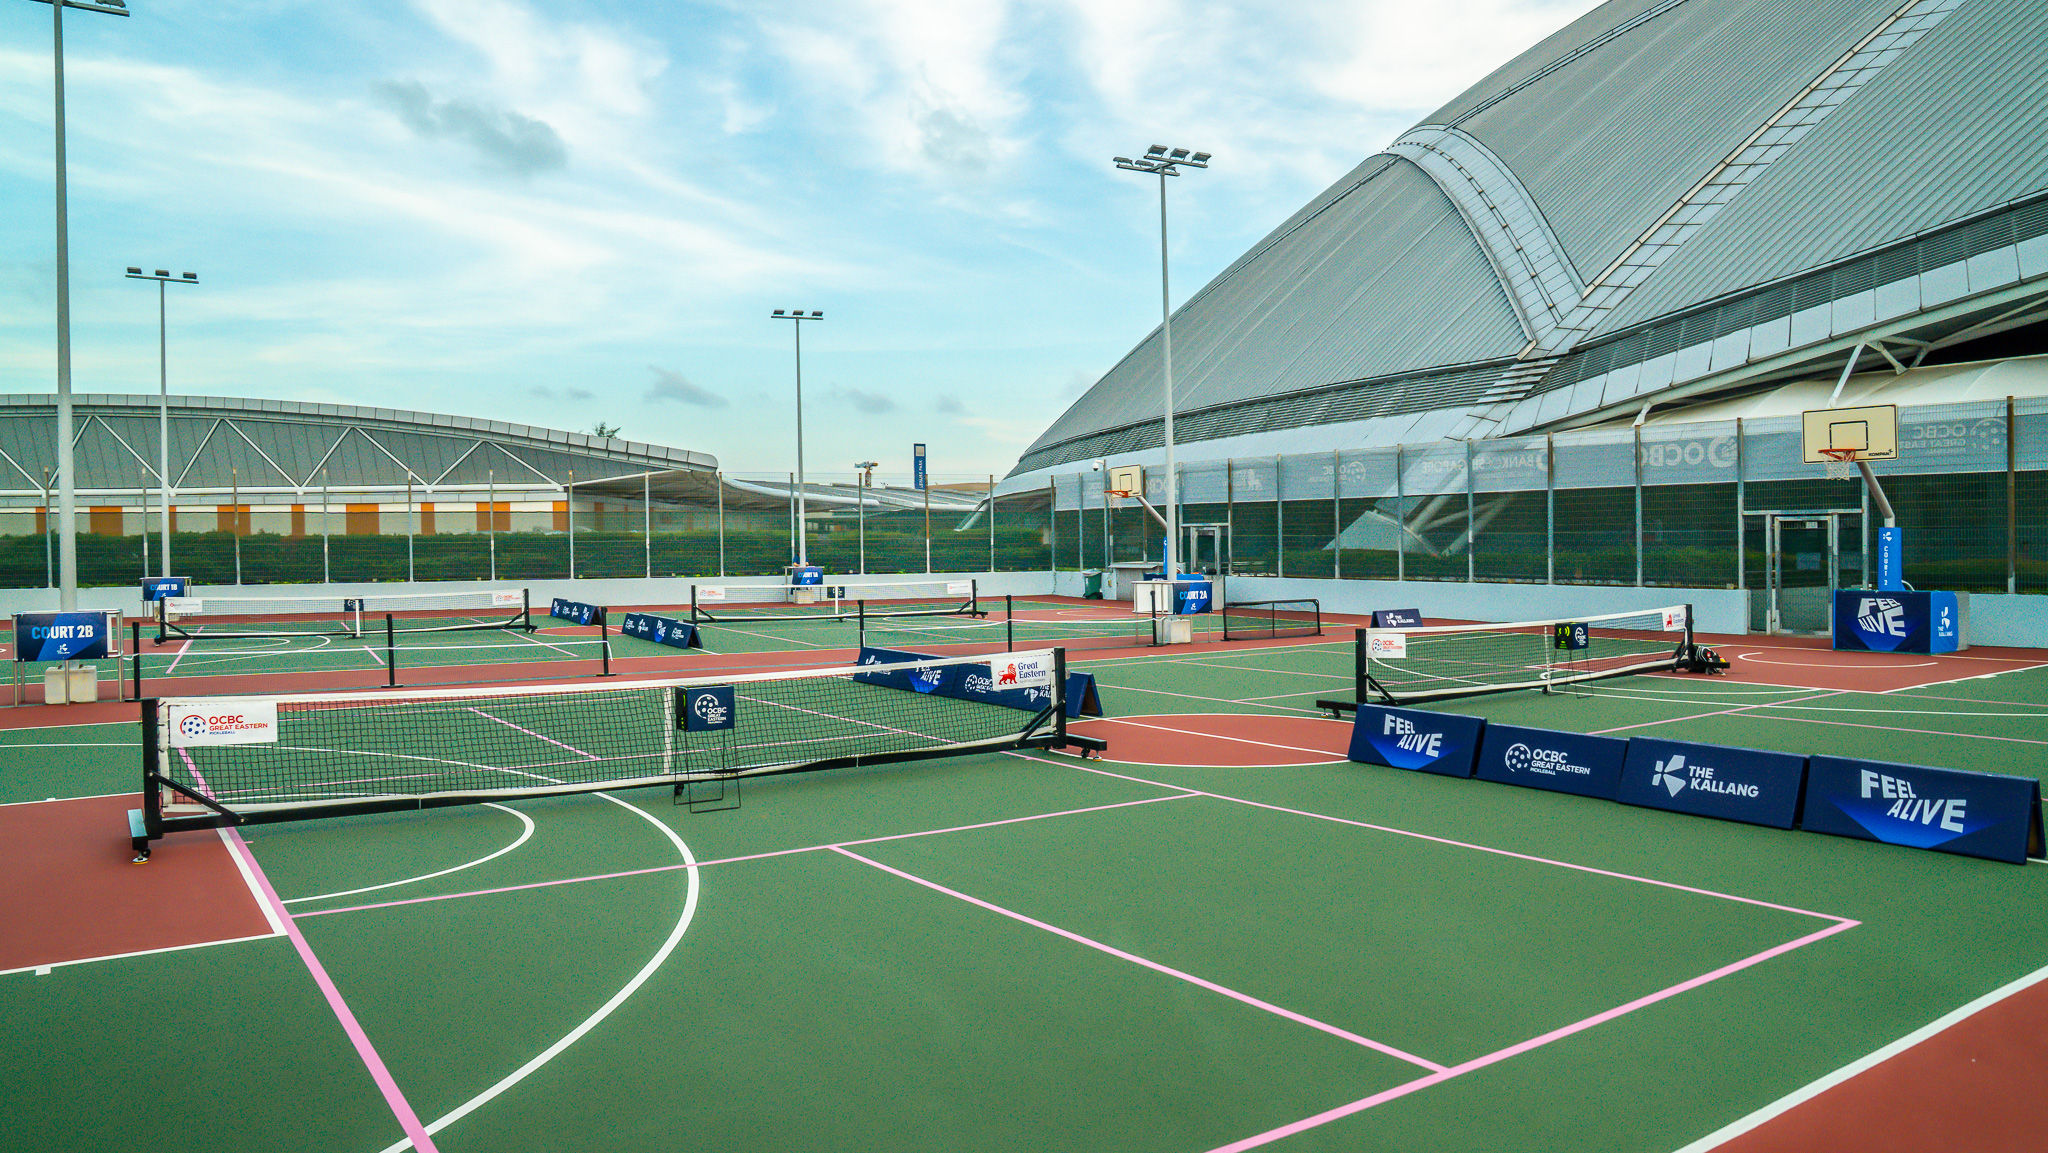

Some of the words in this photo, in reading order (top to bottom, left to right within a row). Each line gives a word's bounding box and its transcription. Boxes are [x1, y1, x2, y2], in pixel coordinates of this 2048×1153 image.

[1180, 590, 1199, 600] COURT
[1199, 590, 1208, 600] 2A
[1858, 597, 1901, 618] FEEL
[1857, 605, 1906, 637] ALIVE
[31, 626, 74, 640] COURT
[77, 625, 94, 638] 2B
[1018, 661, 1038, 671] Great
[1019, 669, 1046, 679] Eastern
[707, 706, 727, 714] OCBC
[209, 714, 243, 725] OCBC
[209, 724, 233, 732] GREAT
[234, 722, 268, 731] EASTERN
[1383, 713, 1415, 735] FEEL
[1396, 733, 1443, 758] ALIVE
[1532, 748, 1568, 764] OCBC
[1530, 767, 1556, 776] PICKLEBALL
[1531, 760, 1556, 770] GREAT
[1556, 763, 1591, 775] EASTERN
[1689, 765, 1715, 779] THE
[1690, 777, 1760, 798] KALLANG
[1861, 769, 1917, 799] FEEL
[1886, 799, 1967, 833] ALIVE
